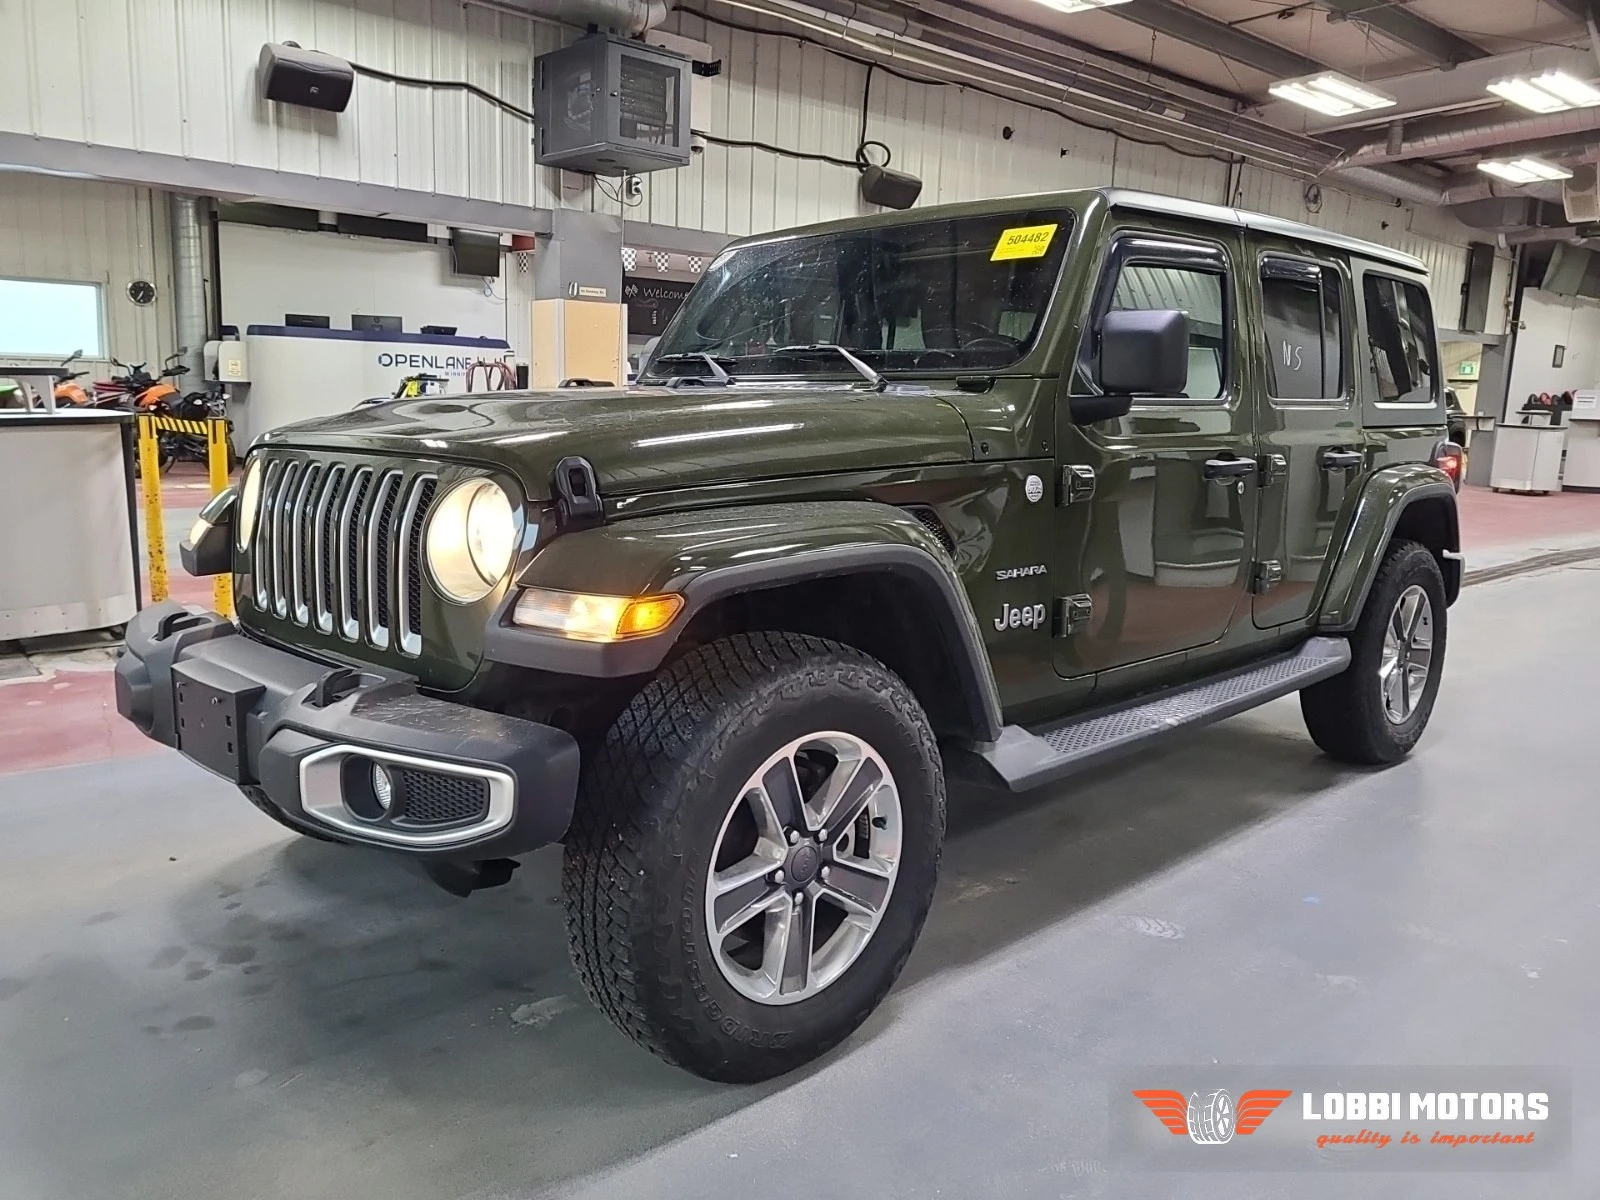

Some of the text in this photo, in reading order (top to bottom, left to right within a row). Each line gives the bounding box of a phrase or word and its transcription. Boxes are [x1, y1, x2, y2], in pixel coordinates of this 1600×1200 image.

[1007, 232, 1050, 245] 504482
[996, 565, 1048, 580] SAHARA
[994, 603, 1046, 631] Jeep
